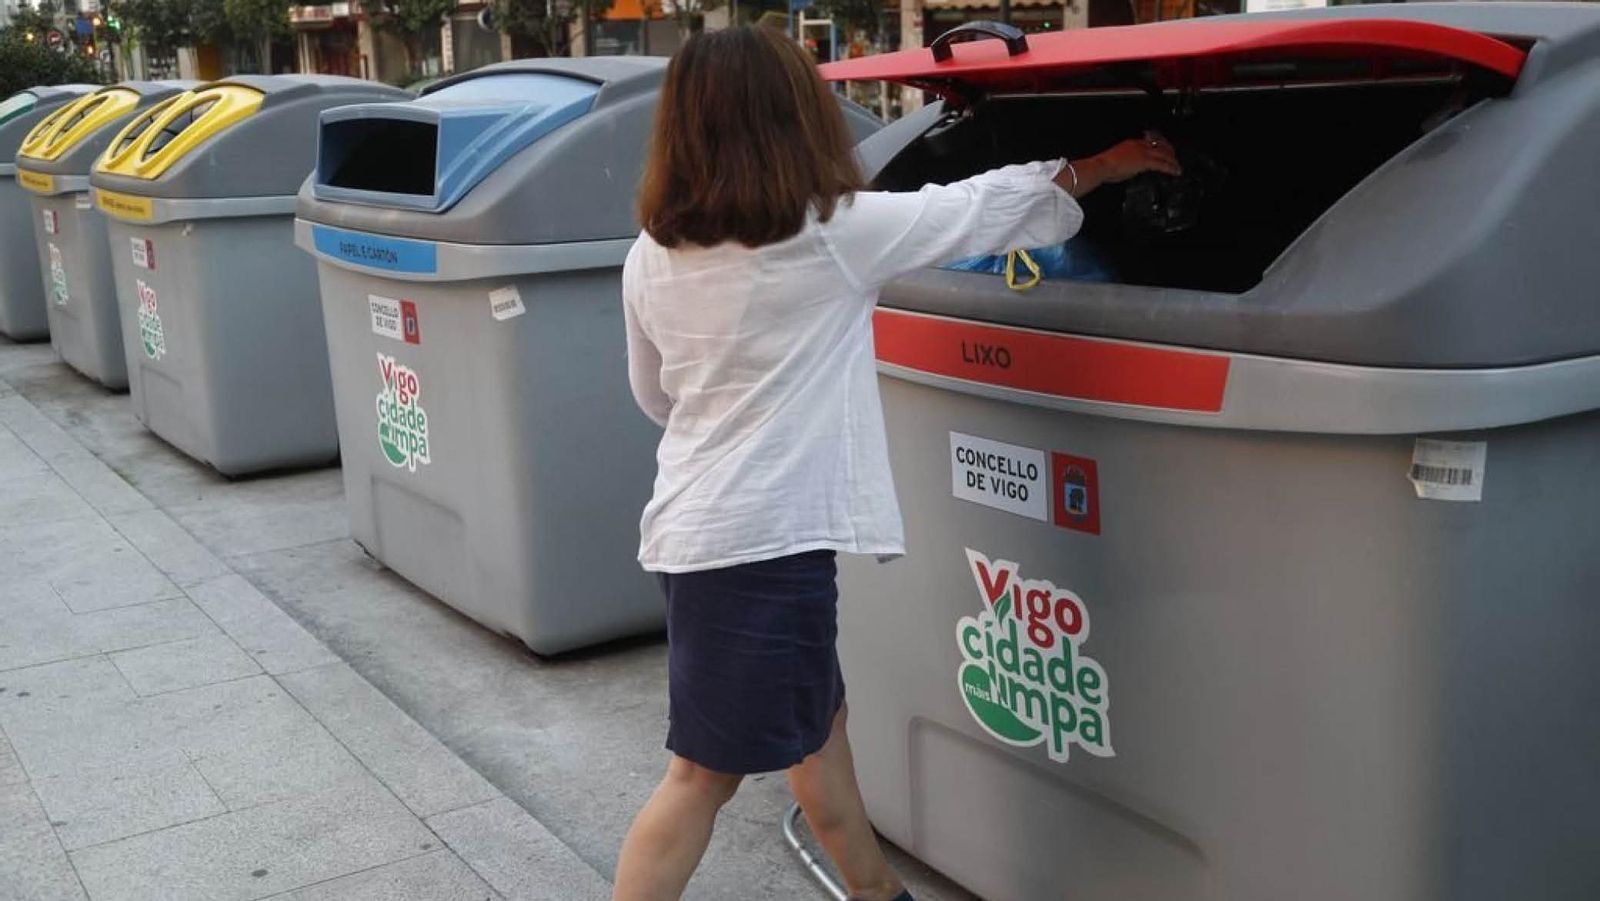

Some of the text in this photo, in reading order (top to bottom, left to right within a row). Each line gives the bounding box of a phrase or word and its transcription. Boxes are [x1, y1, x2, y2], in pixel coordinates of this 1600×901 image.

[962, 341, 1012, 370] LIXO
[380, 358, 417, 405] Vigo
[377, 392, 426, 434] cidade
[955, 446, 1038, 482] CONCELLO
[966, 470, 1029, 502] DE VIGO
[975, 561, 1083, 649] Vigo
[962, 619, 1102, 705] cidade
